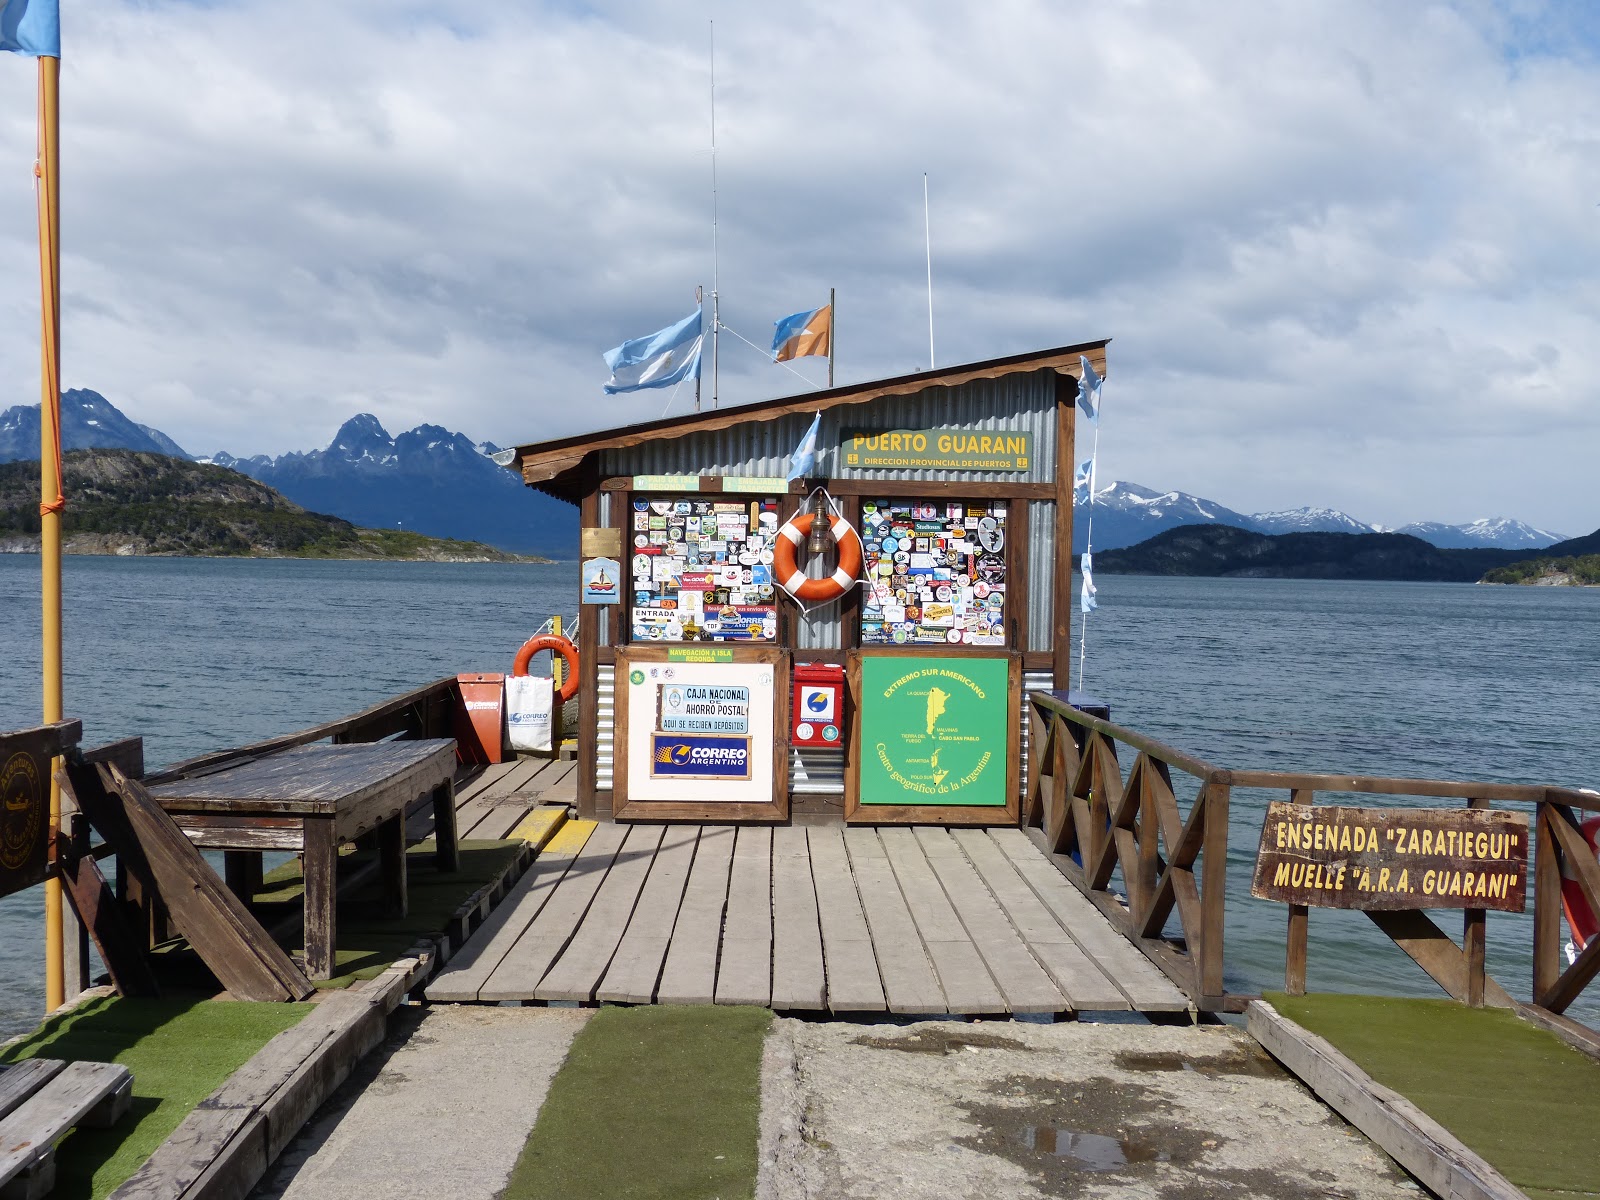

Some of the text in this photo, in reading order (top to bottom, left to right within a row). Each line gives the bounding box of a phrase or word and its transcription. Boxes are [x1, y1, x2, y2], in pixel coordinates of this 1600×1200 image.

[853, 433, 1026, 455] PUERTO GUARANI
[864, 457, 909, 466] DIRECCION
[910, 458, 960, 467] PROVINCIAL
[973, 460, 1011, 468] PUERTOS
[883, 668, 986, 699] EXTREMO SUR AMERICANO
[686, 688, 745, 700] CAJA NACIONAL
[686, 704, 745, 716] AHORRO POSTAL
[679, 720, 686, 729] SE
[688, 720, 711, 729] RECIBEN
[692, 747, 747, 759] CORREO
[690, 758, 744, 766] ARGENTINO
[876, 743, 992, 794] Centro geográfico de la Argentina
[1276, 821, 1518, 860] ENSENADA "ZARATIEGUI"
[1273, 862, 1346, 890] MUELLE
[1422, 869, 1518, 900] GUARANI"
